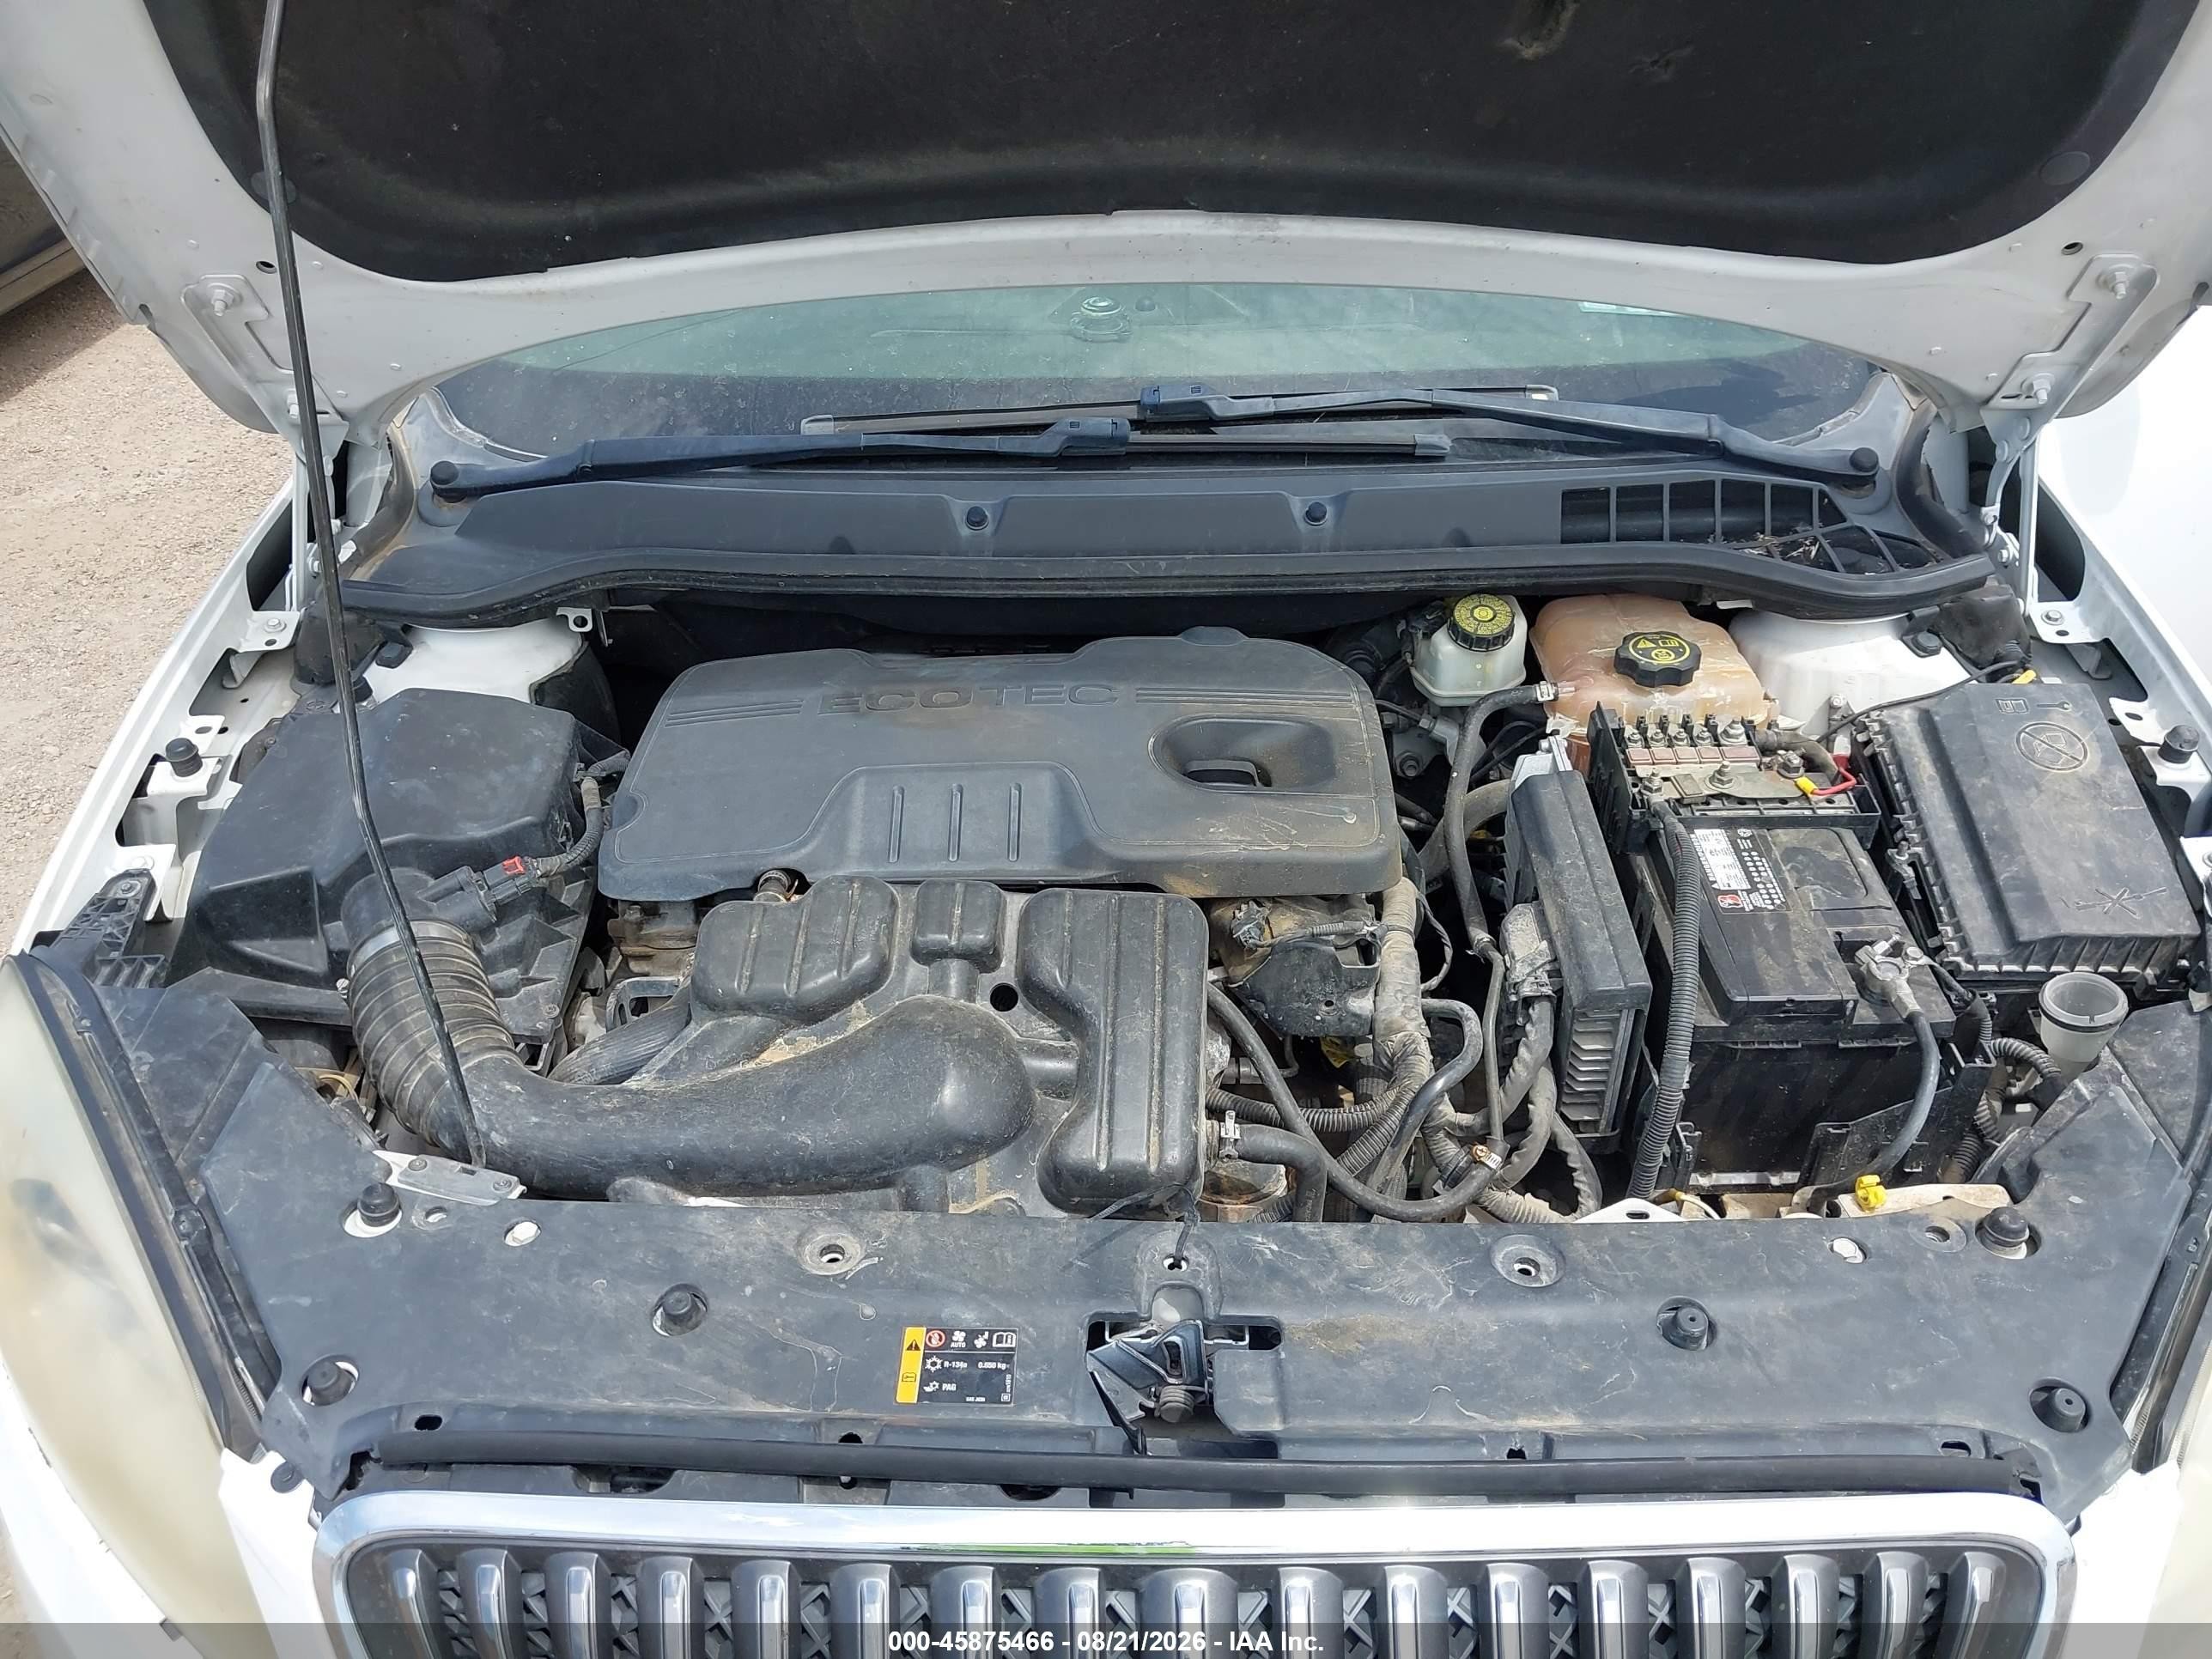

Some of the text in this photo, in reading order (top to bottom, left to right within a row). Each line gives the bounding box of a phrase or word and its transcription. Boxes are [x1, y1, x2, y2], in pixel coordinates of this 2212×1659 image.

[817, 684, 1119, 715] ECOTEC
[944, 1361, 968, 1370] R-134a
[997, 1361, 1007, 1370] kg
